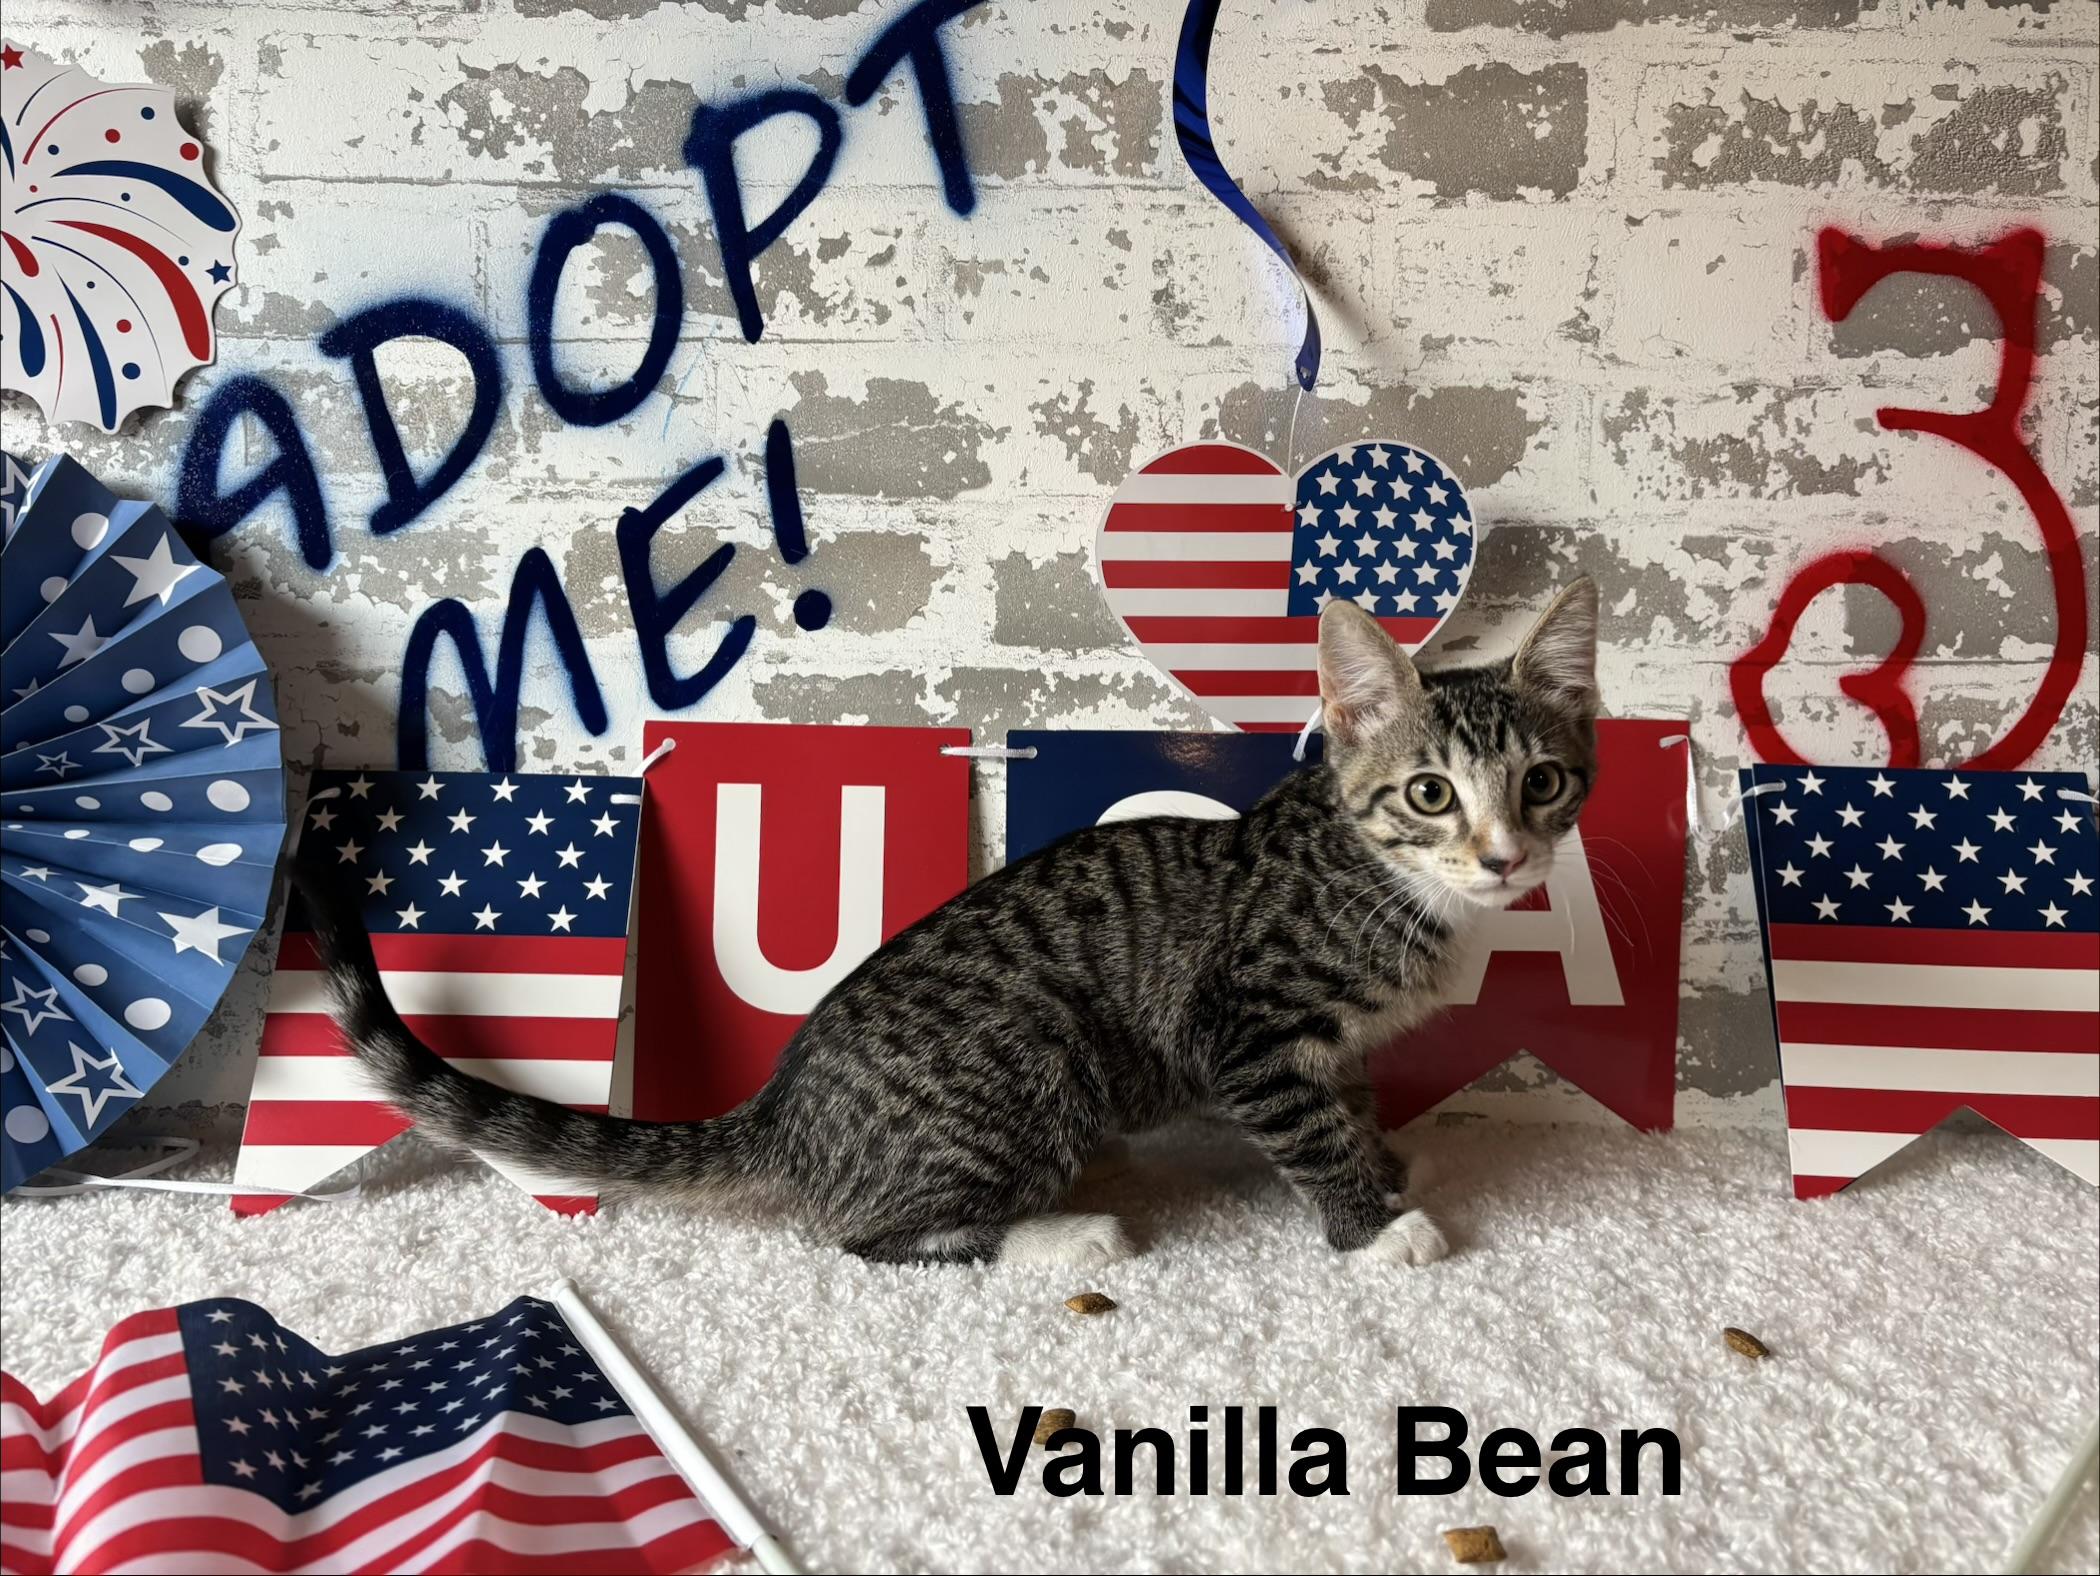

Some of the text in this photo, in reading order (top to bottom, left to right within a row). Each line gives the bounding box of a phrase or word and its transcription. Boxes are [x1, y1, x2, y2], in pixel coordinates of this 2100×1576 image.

[173, 0, 984, 571] ADOPT
[399, 418, 833, 772] ME!
[712, 781, 1625, 1016] UA
